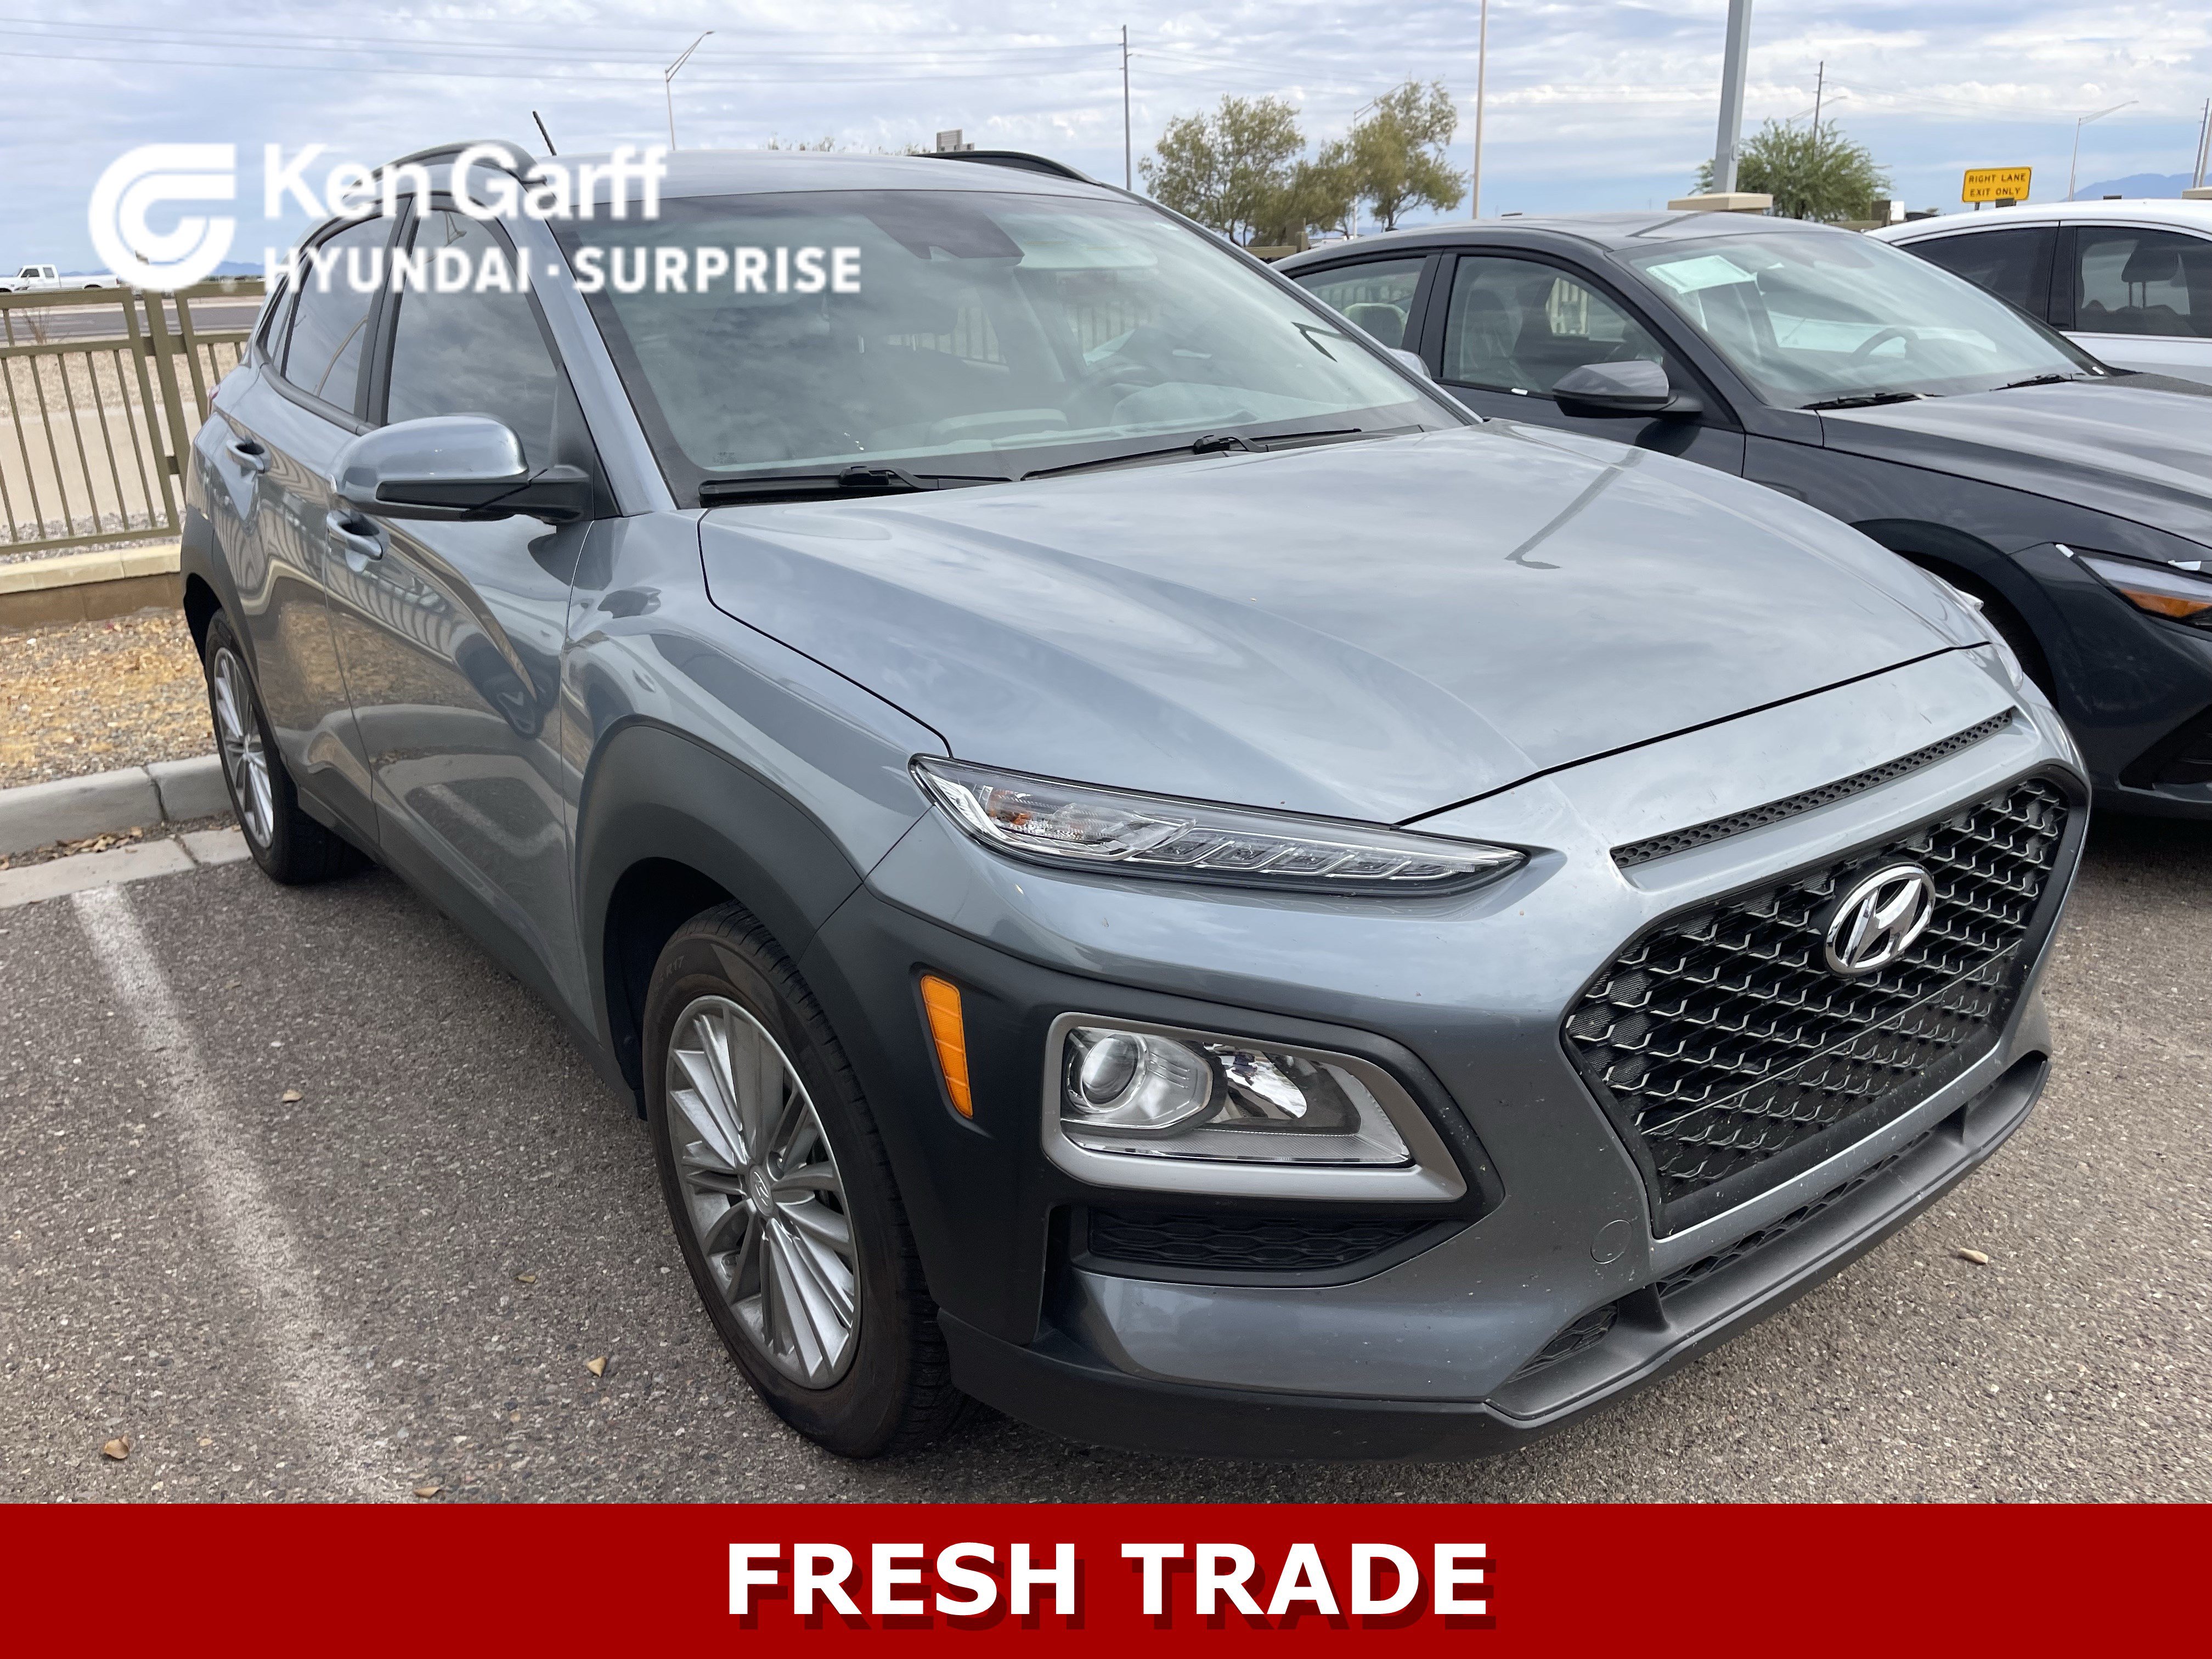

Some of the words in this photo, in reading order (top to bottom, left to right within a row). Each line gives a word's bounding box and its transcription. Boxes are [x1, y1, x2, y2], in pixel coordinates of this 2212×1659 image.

[1968, 174, 1996, 184] RIGHT
[2001, 172, 2026, 183] LANE
[1970, 188, 1990, 198] EXIT
[1995, 187, 2021, 196] ONLY
